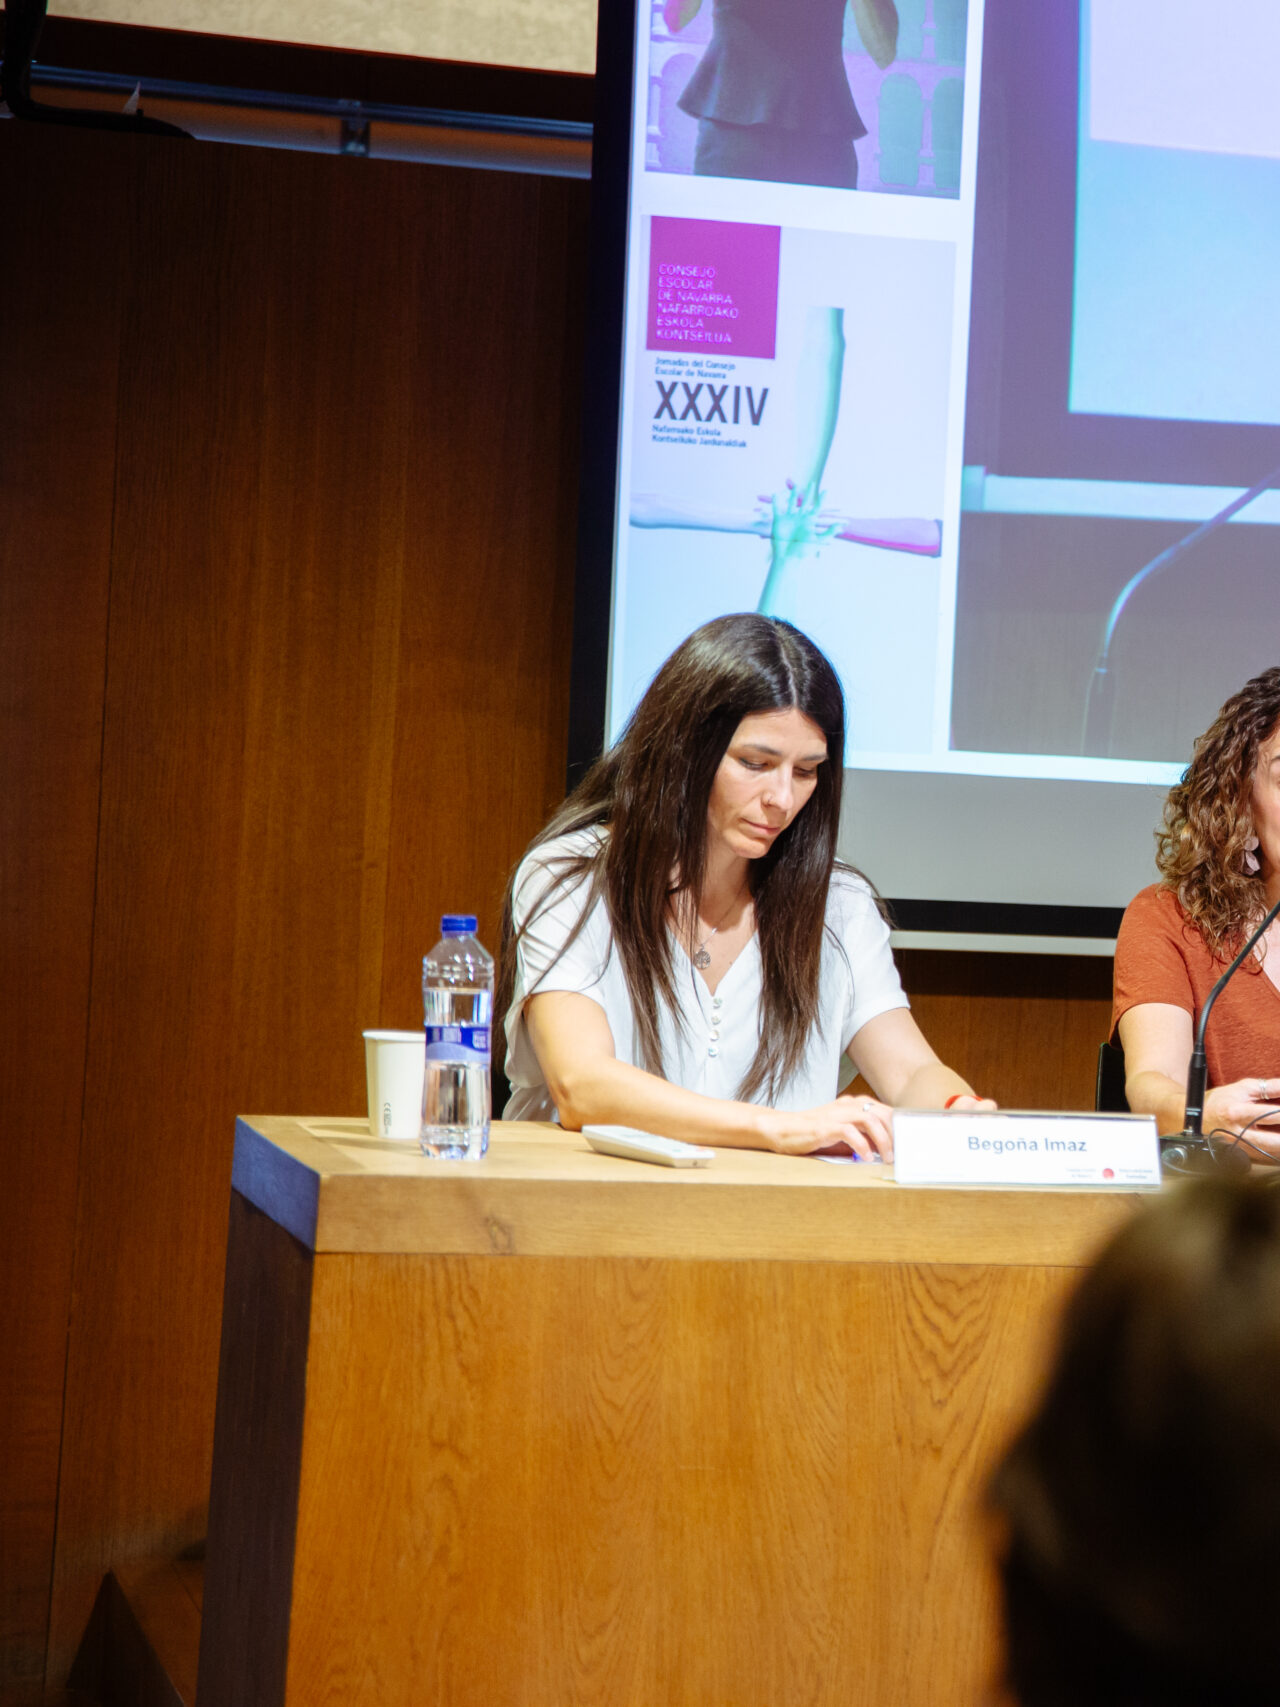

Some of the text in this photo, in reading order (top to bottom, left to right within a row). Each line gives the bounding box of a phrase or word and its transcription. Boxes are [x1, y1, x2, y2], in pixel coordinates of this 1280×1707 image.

[658, 263, 716, 279] CONSEJO
[657, 276, 713, 291] ESCOLAR
[657, 289, 733, 305] DE NAVARRA
[656, 302, 739, 319] NAFARROAKO
[656, 316, 704, 329] ESKOLA
[656, 329, 732, 344] KONTSEILUA
[653, 380, 769, 426] XXXIV
[967, 1136, 1087, 1154] Begoña Imaz
